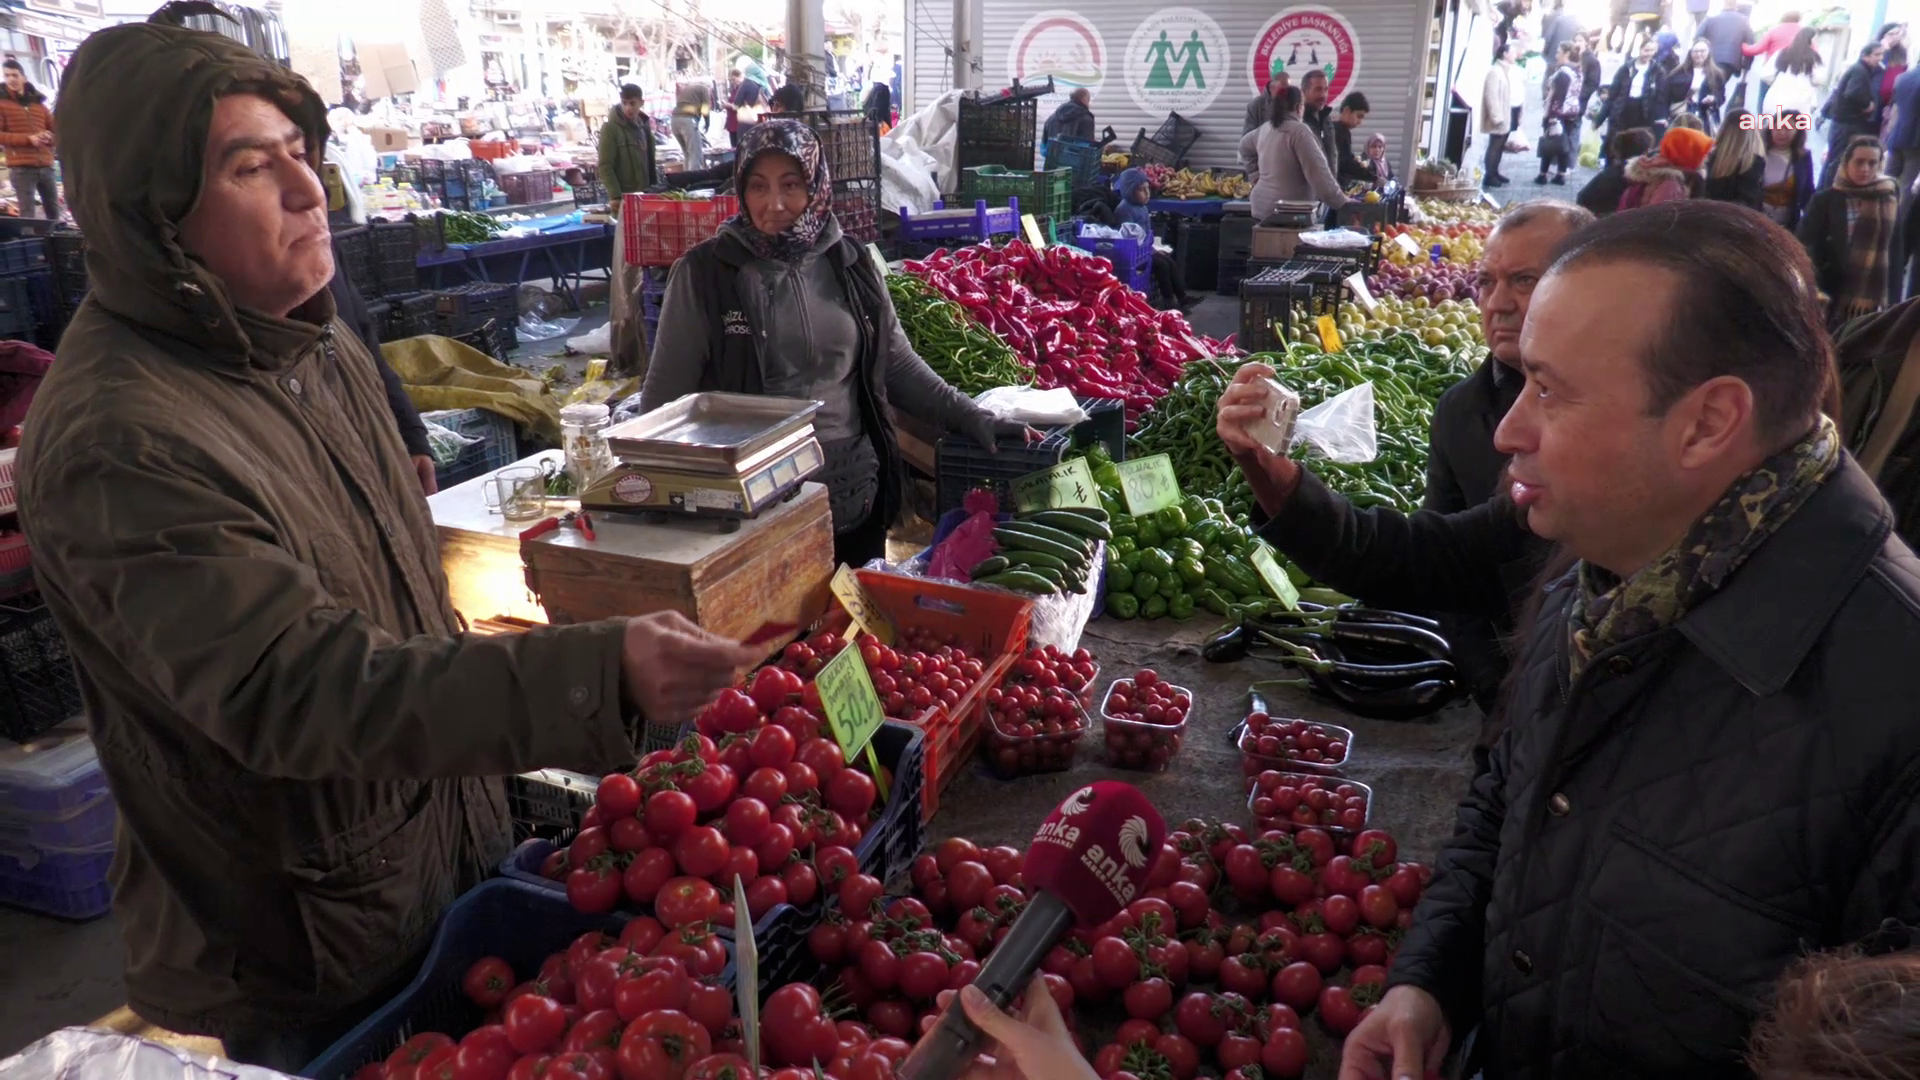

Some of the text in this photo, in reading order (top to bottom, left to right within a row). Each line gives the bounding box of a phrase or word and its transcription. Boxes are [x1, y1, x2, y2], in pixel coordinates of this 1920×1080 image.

[1260, 17, 1300, 56] BELEDİYE
[1301, 16, 1349, 54] BAŞKANLIĞI
[1036, 816, 1080, 842] anka
[1080, 854, 1106, 882] HABER
[1087, 844, 1136, 902] anka
